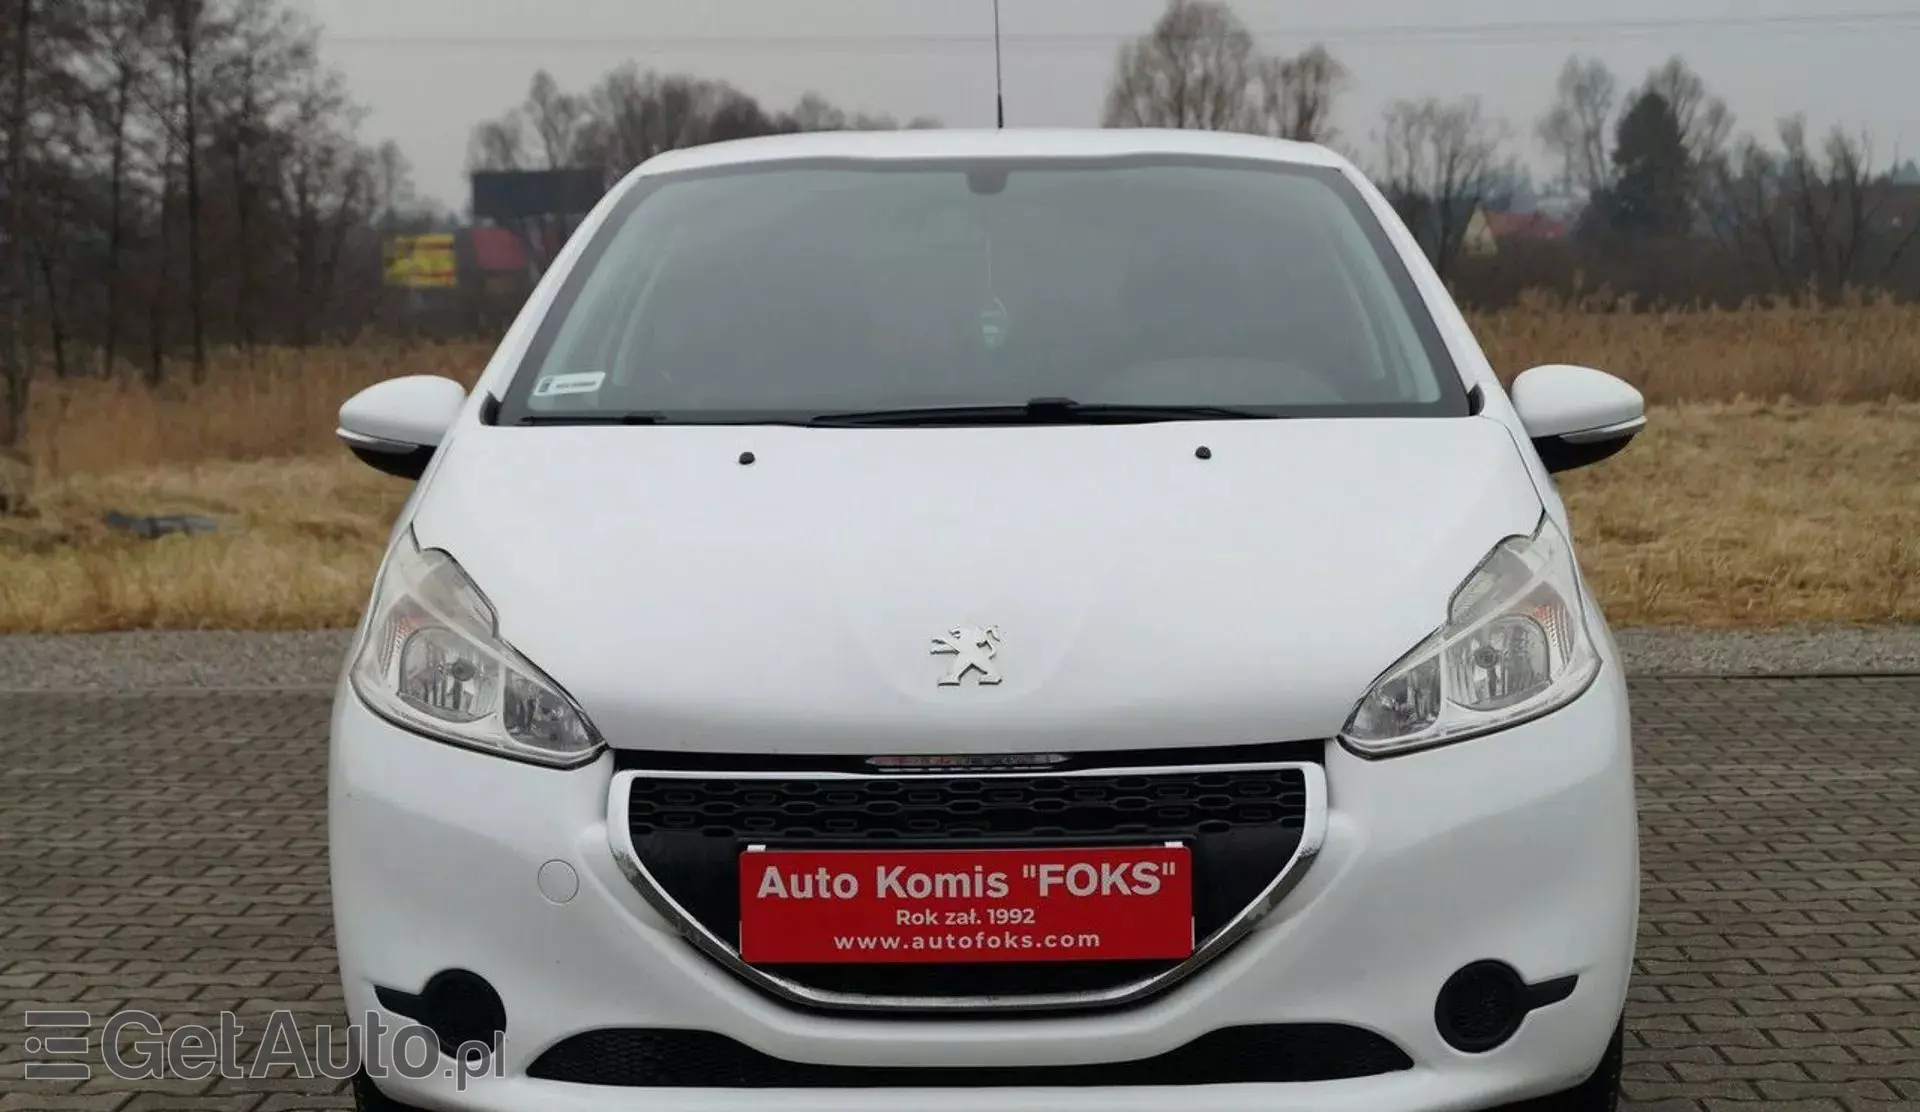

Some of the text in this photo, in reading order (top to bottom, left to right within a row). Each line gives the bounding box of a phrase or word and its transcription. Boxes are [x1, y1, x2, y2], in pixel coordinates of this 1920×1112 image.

[757, 861, 1177, 899] Auto Komis "FOKS"
[896, 907, 1036, 926] Rok zał. 1992
[833, 931, 1101, 950] www.autofoks.com
